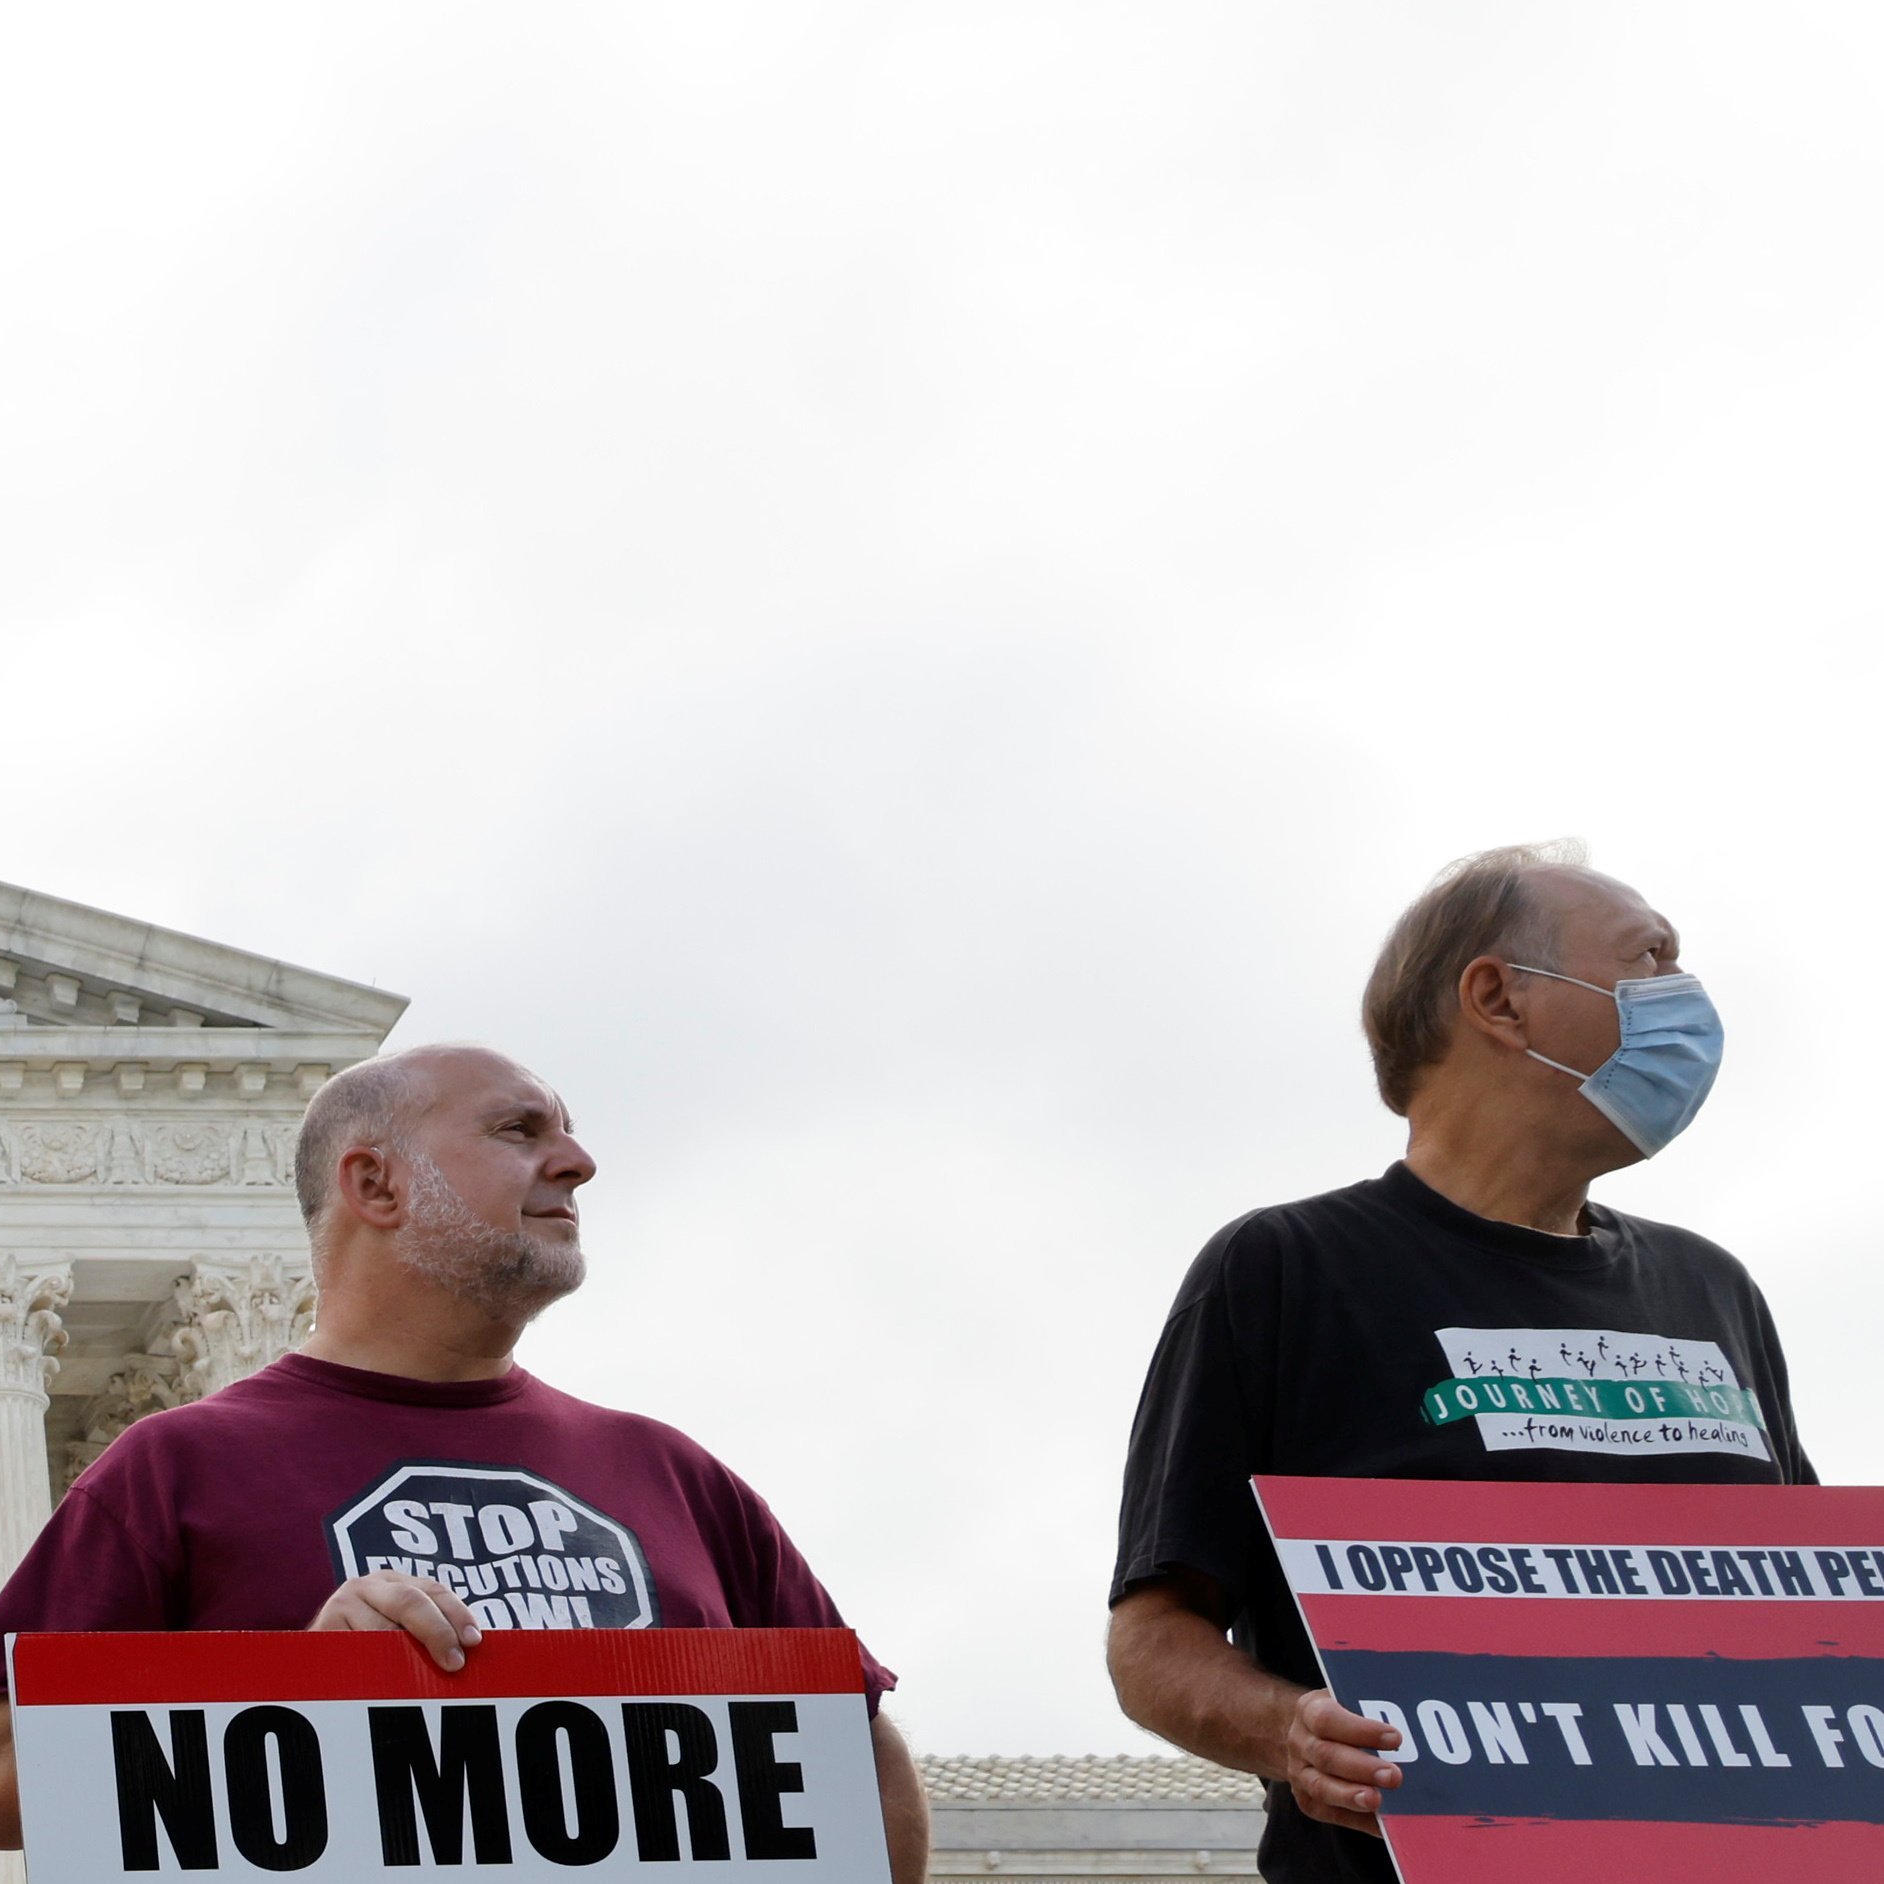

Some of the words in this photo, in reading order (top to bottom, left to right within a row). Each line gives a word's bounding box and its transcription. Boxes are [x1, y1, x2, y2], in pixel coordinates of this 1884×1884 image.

[1433, 1384, 1601, 1419] JOURNEY
[1624, 1387, 1666, 1414] OF
[1580, 1421, 1655, 1444] violence
[1658, 1423, 1684, 1443] to
[1688, 1419, 1748, 1447] healing
[383, 1500, 578, 1560] STOP
[1315, 1544, 1344, 1590] I
[1348, 1544, 1546, 1594] OPPOSE
[1545, 1549, 1649, 1595] THE
[1650, 1550, 1816, 1596] DEATH
[468, 1592, 595, 1630] OW!
[1357, 1699, 1593, 1766] DON'T
[1613, 1703, 1793, 1767] KILL
[110, 1704, 329, 1873] NO
[368, 1699, 818, 1867] MORE
